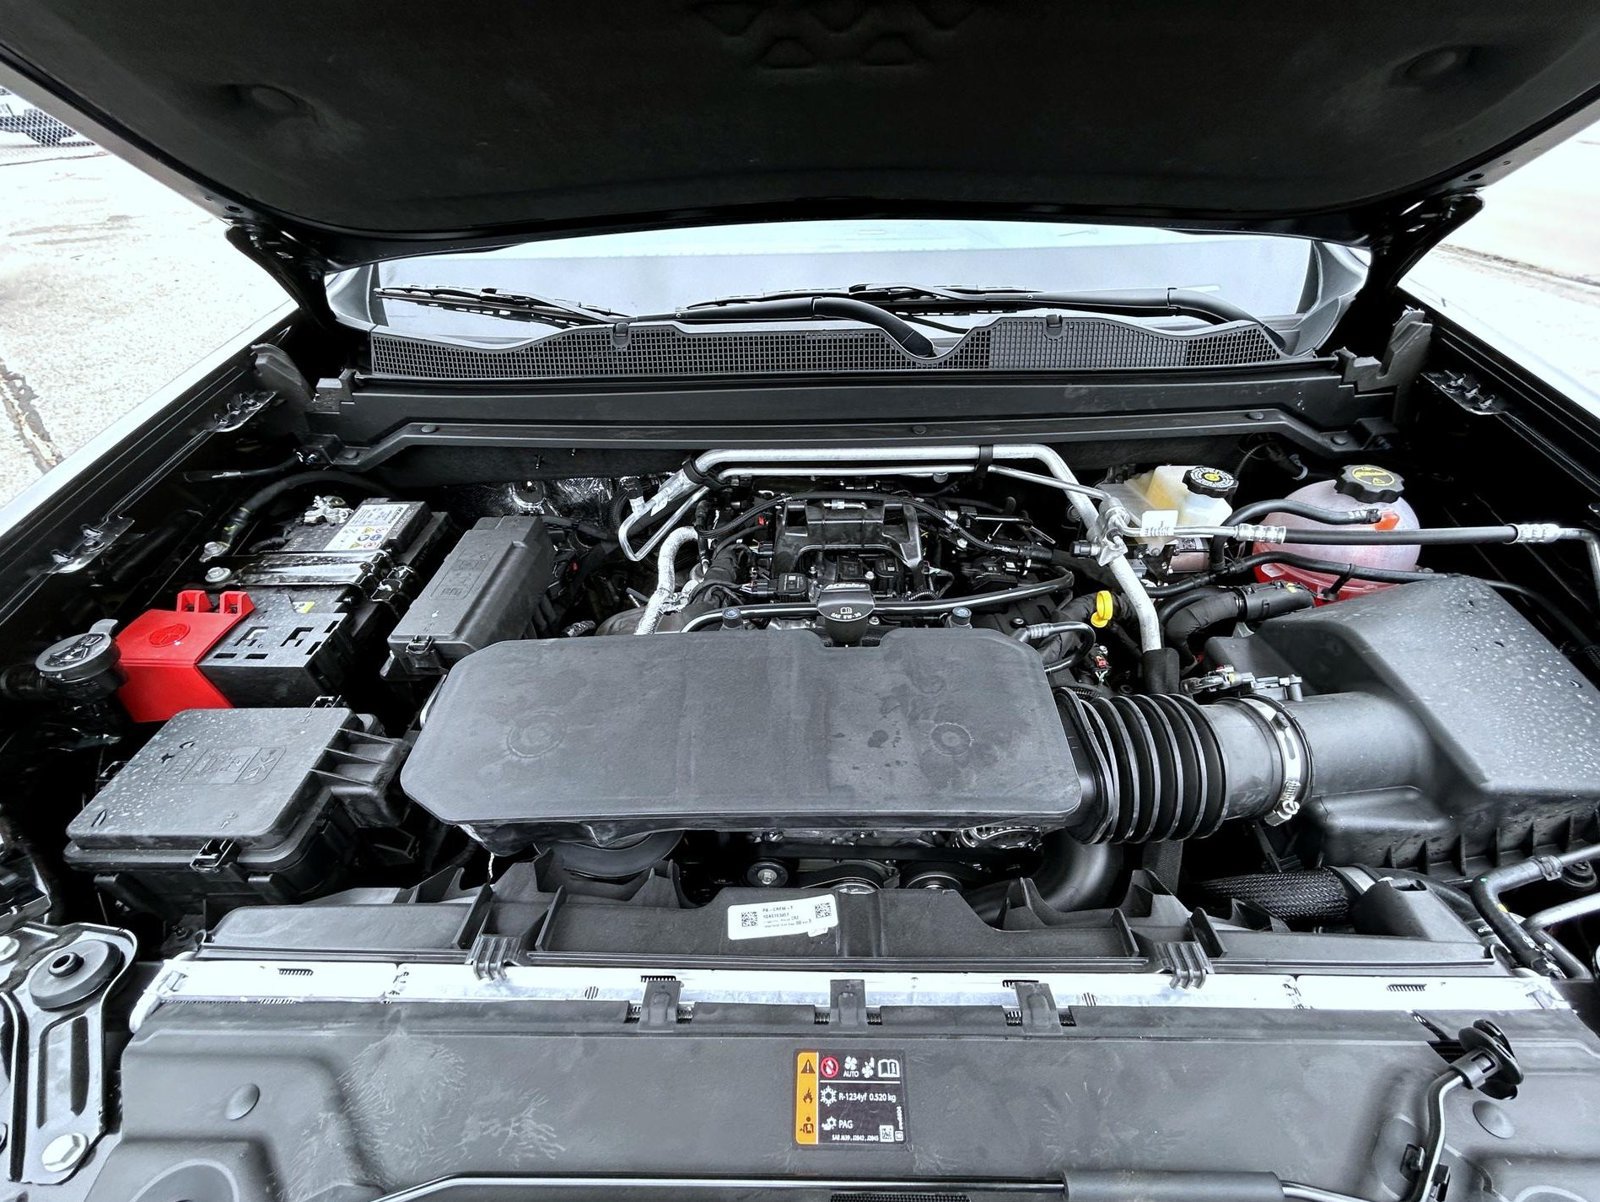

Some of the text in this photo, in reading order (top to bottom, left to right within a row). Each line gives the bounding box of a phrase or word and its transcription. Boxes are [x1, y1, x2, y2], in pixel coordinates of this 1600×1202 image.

[838, 1092, 896, 1103] R-1234yf 0.520 kg
[838, 1120, 853, 1129] PAG
